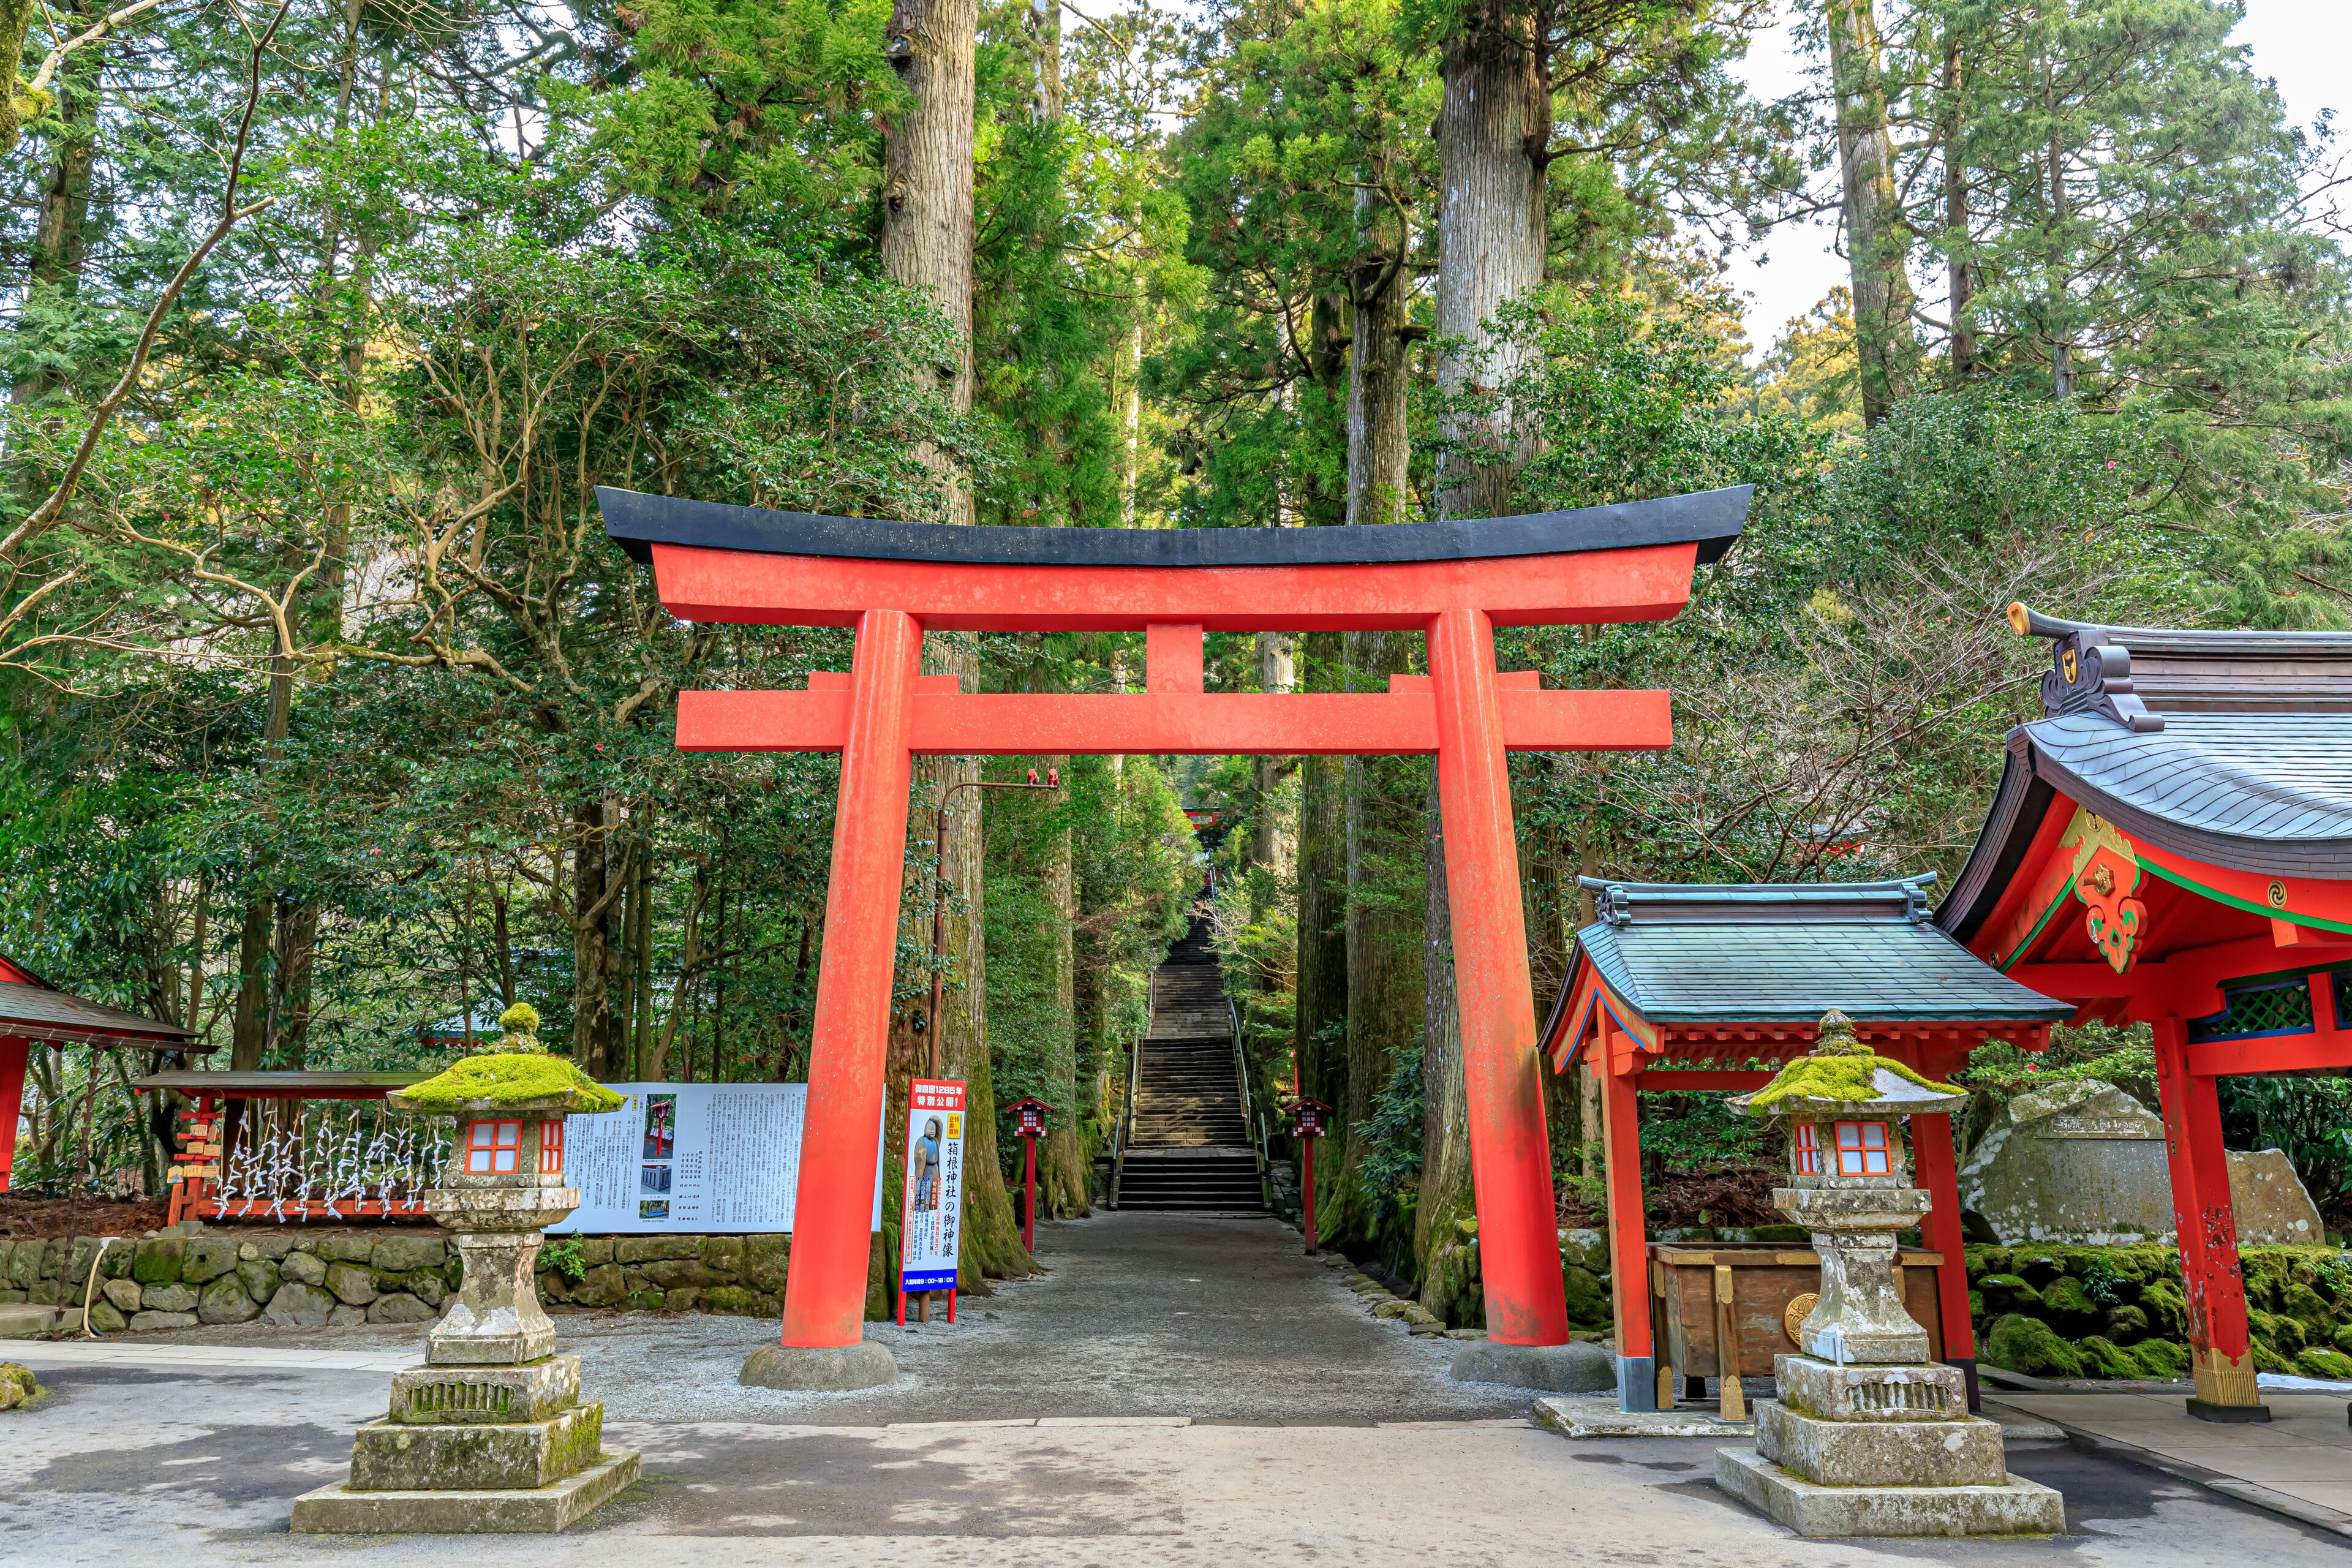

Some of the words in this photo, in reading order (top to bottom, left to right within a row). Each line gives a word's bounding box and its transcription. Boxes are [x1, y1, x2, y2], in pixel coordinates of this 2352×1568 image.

[917, 1095, 958, 1107] 特別公開!
[942, 1142, 958, 1257] 箱根神社の御神像
